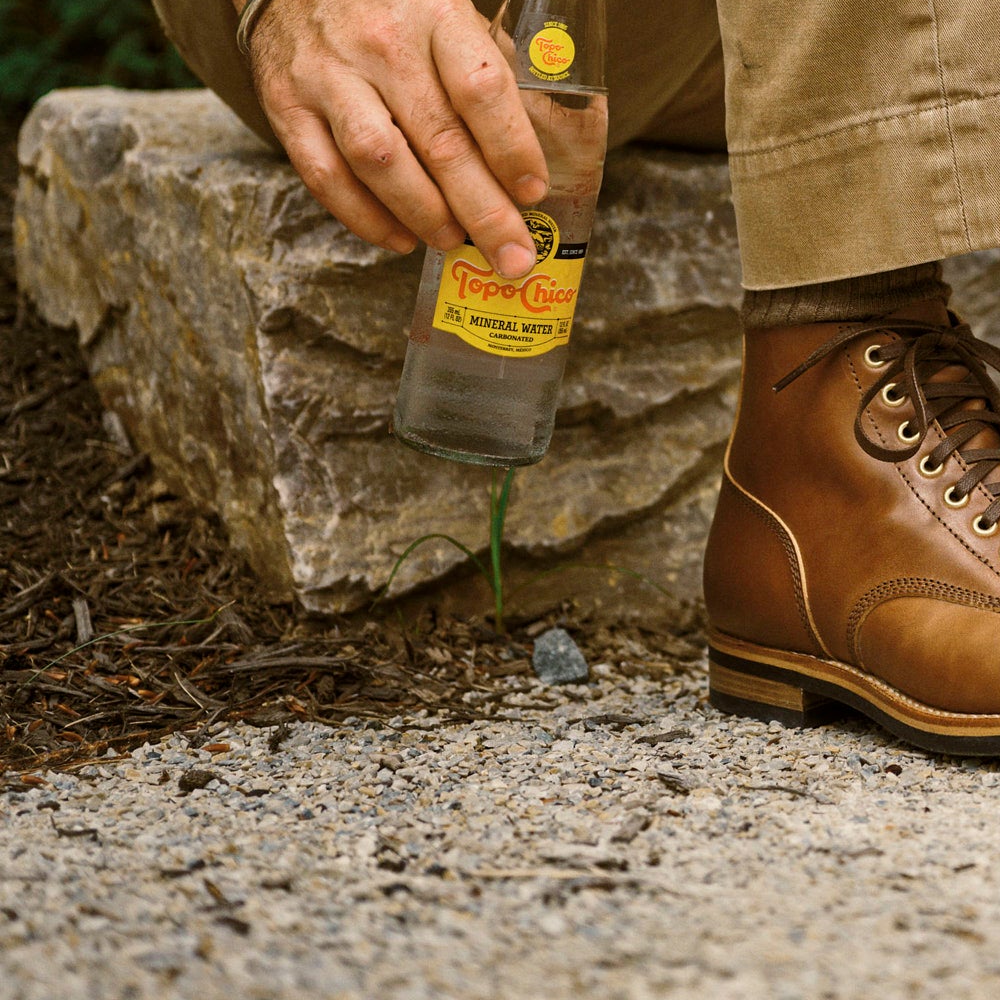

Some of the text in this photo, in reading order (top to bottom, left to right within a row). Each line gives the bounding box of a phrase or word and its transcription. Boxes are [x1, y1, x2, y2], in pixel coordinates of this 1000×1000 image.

[535, 37, 564, 52] Topo
[542, 50, 571, 66] Chico
[451, 258, 577, 313] Topo Chico
[469, 314, 518, 332] MINERAL
[521, 322, 553, 335] WATER
[489, 332, 534, 343] CARBONATED
